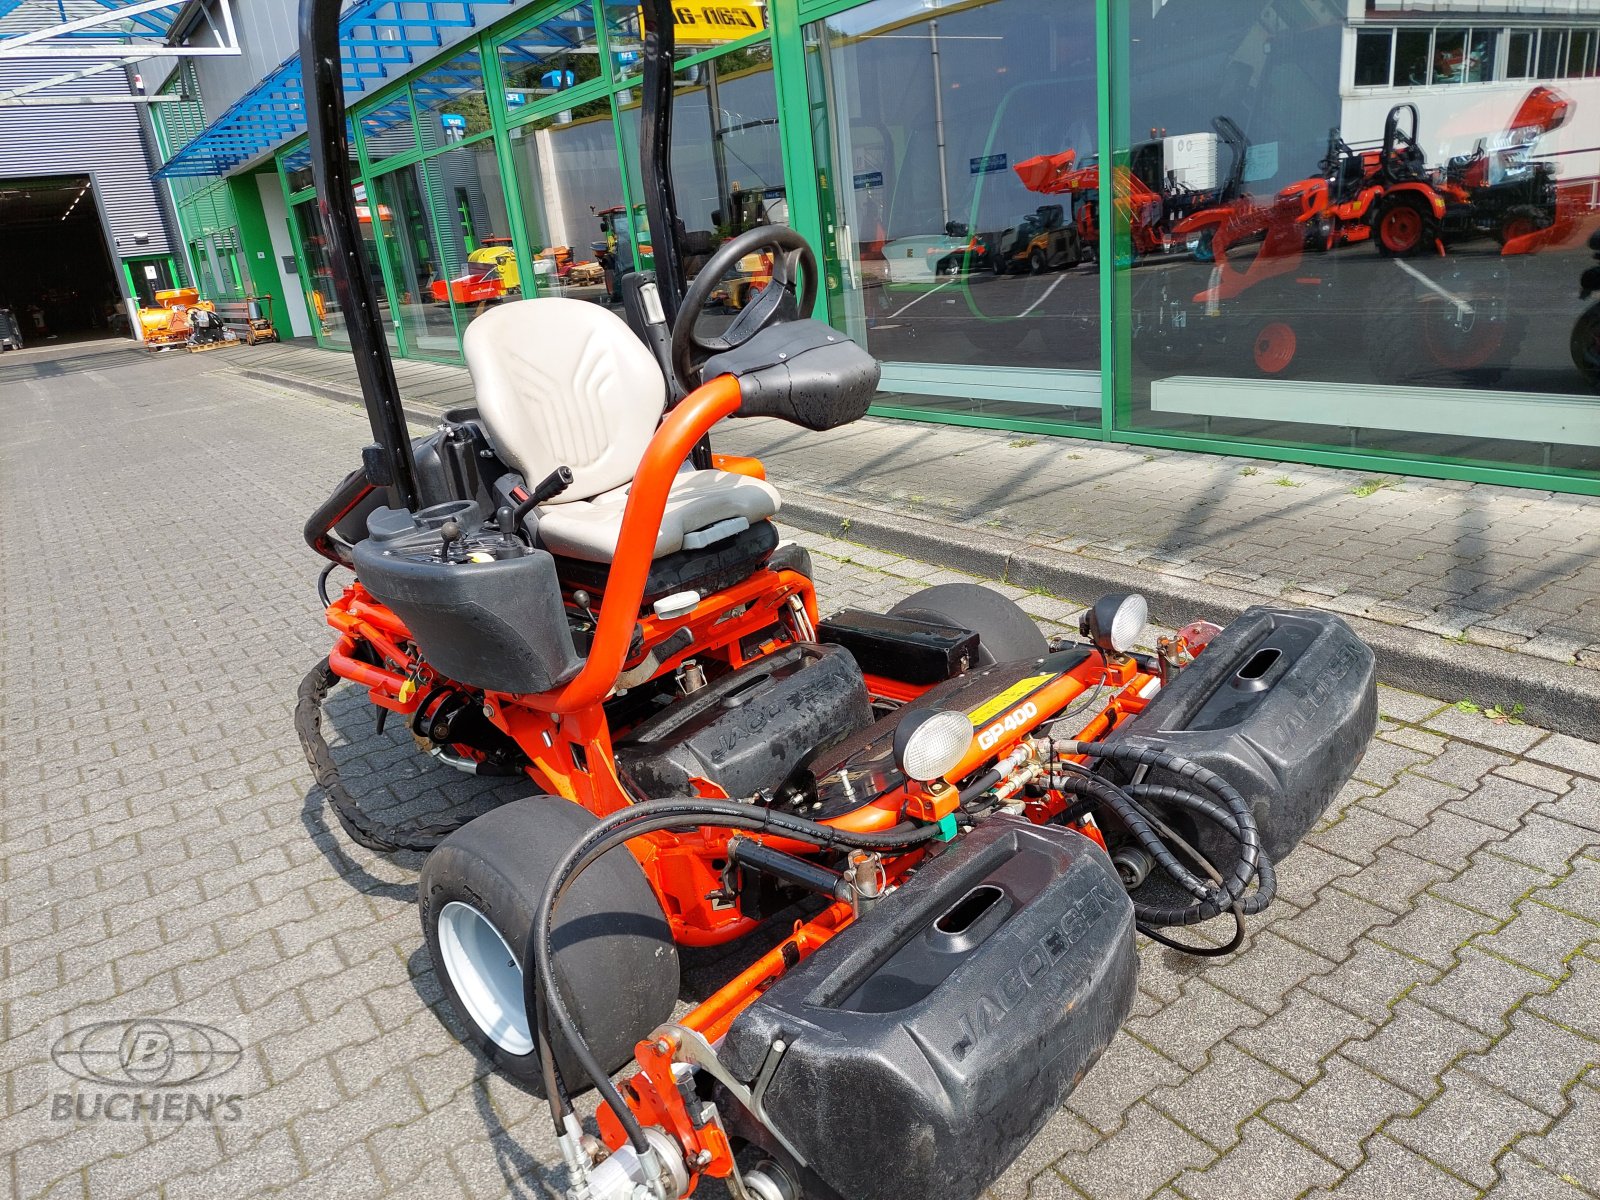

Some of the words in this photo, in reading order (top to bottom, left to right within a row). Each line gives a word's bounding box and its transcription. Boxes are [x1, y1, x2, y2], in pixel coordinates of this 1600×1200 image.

[977, 701, 1038, 751] GP400
[1276, 636, 1365, 754] JACOBSEN
[952, 877, 1120, 1063] JACOBSEN
